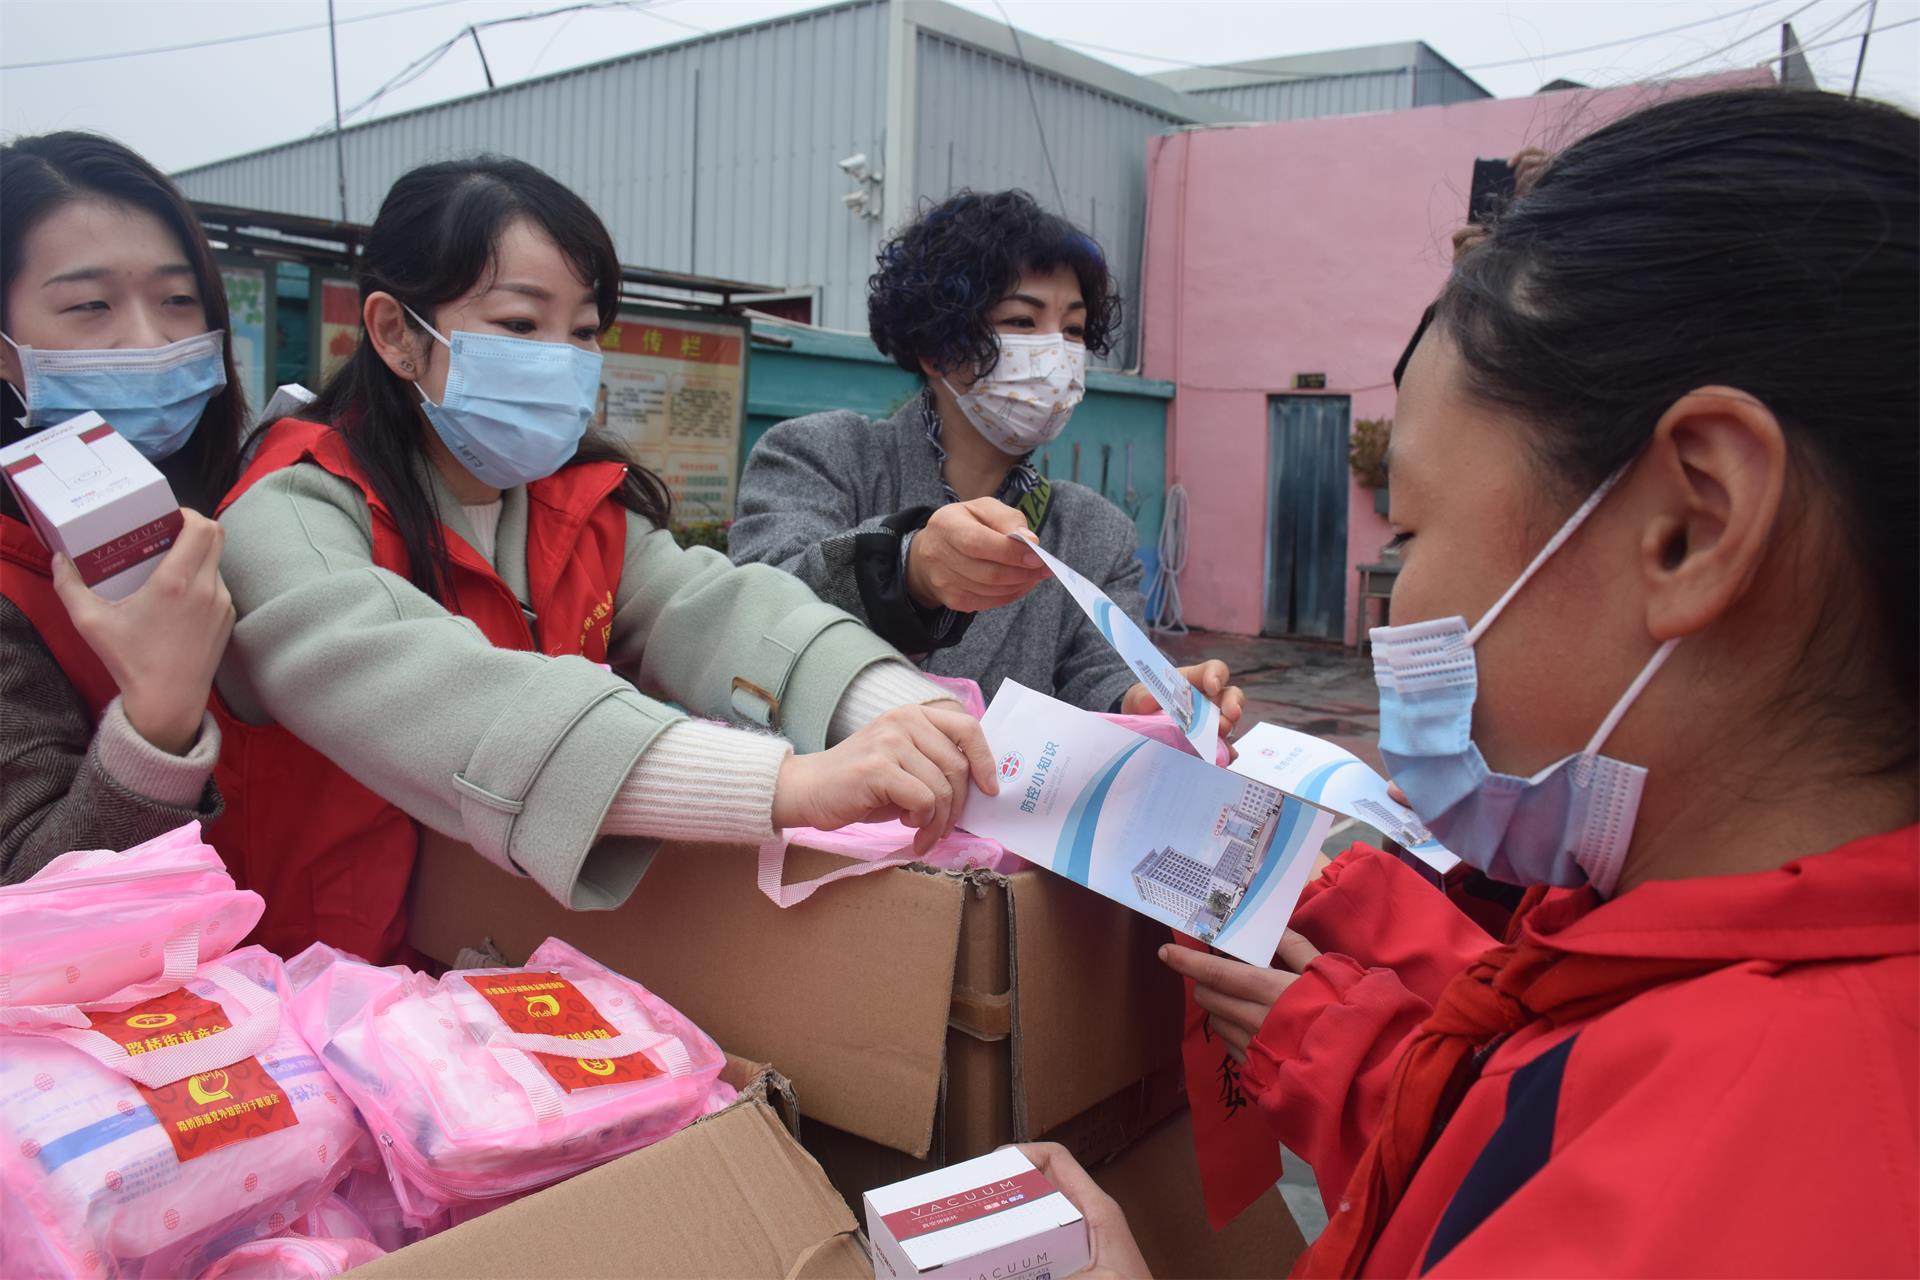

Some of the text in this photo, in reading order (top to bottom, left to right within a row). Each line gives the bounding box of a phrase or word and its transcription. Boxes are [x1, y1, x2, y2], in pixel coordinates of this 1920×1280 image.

[93, 521, 165, 560] VACUUM
[1020, 741, 1060, 814] 防控小知识
[910, 1180, 1015, 1217] VACUUM
[969, 1252, 1048, 1280] ACUUM
